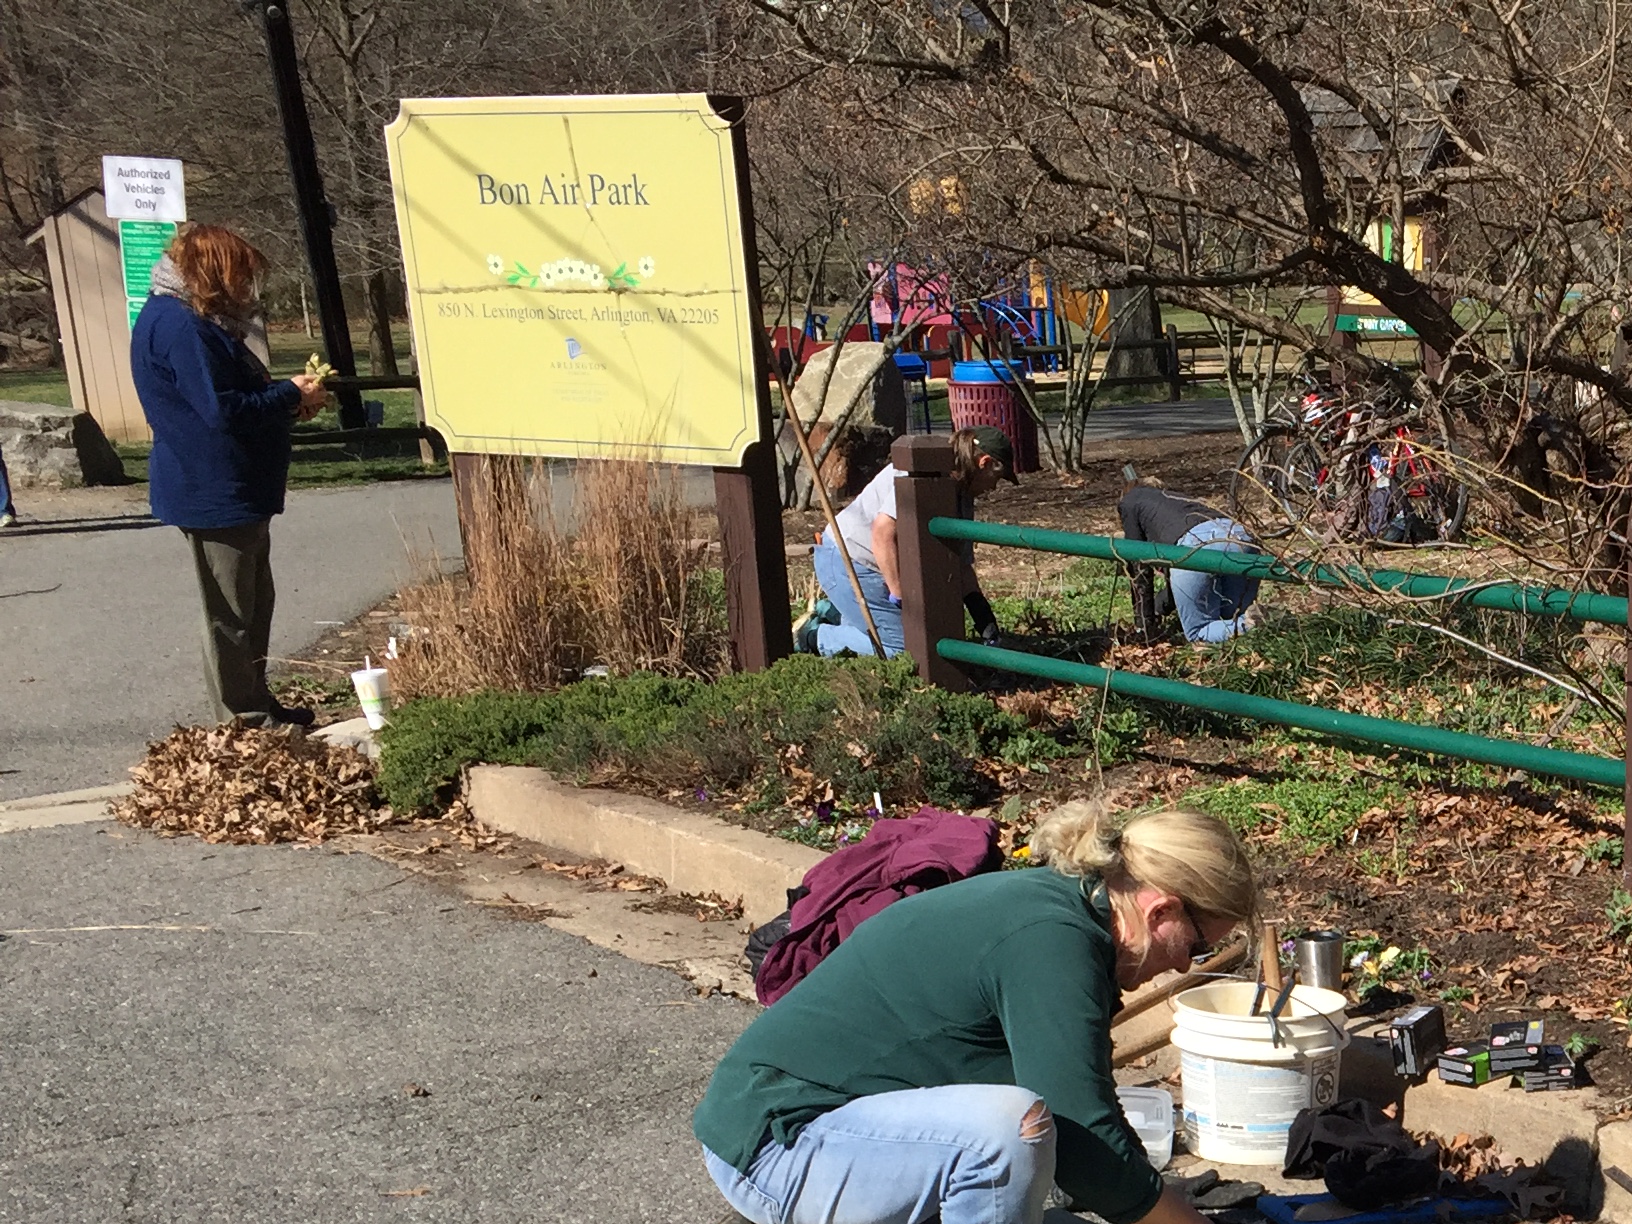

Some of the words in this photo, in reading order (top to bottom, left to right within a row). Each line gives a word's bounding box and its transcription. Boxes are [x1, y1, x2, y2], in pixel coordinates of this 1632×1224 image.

[117, 167, 171, 180] Authorized
[124, 182, 166, 195] Vehicles
[476, 173, 531, 205] Bon
[539, 173, 580, 206] Air
[588, 173, 650, 206] Park
[135, 198, 157, 212] Only
[438, 303, 461, 318] 850
[464, 303, 478, 319] N.
[482, 305, 543, 322] Lexington
[548, 305, 587, 322] Street,
[591, 308, 653, 325] Arlington,
[657, 308, 678, 323] VA
[681, 308, 719, 325] 22205
[550, 361, 607, 370] ARLINGTON
